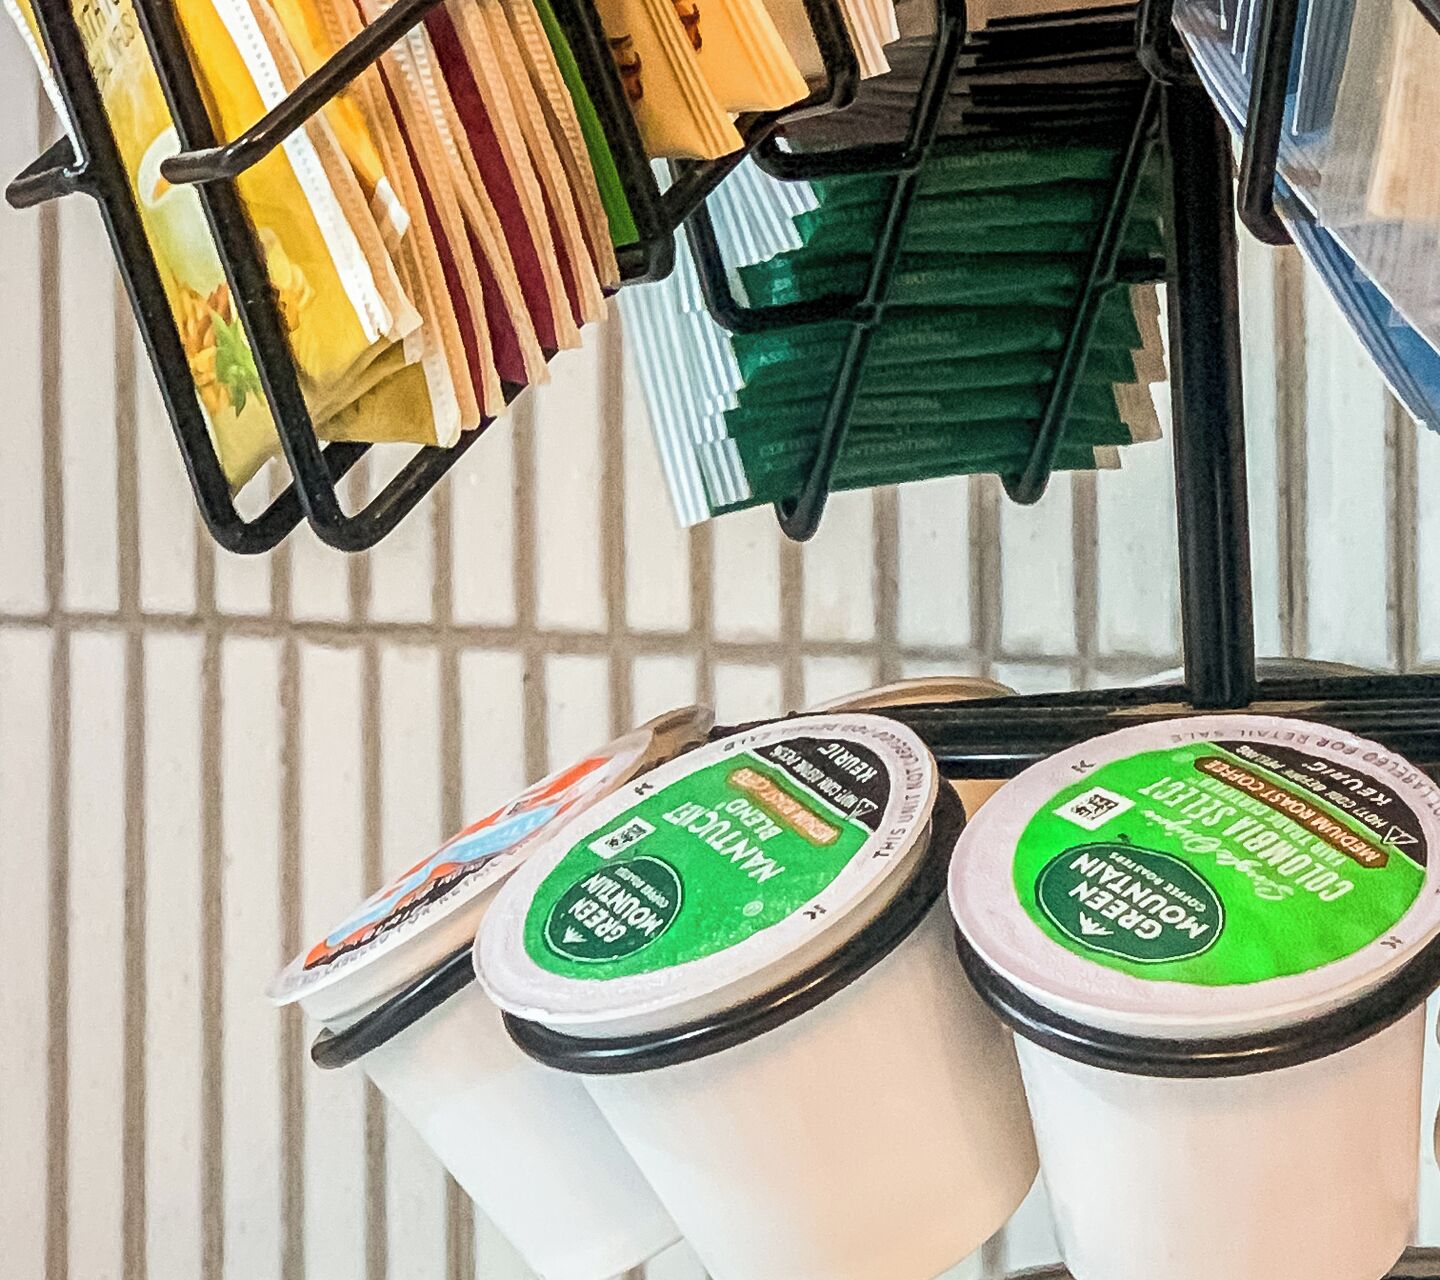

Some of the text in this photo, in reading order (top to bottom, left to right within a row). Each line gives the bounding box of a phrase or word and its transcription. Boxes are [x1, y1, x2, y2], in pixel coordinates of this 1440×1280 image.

[816, 743, 878, 784] KEURIG
[1315, 736, 1360, 756] FOR
[1202, 758, 1382, 863] MEDIUM ROAST COFFEE
[1303, 761, 1393, 807] KEURIG
[661, 800, 786, 884] NANTUCKET
[725, 798, 784, 841] BLEND
[872, 827, 907, 859] THIS
[899, 792, 922, 824] UNIT
[1138, 776, 1356, 903] COLOMBIA SELECT
[568, 897, 627, 943] GREEN
[1068, 852, 1211, 940] MOUNTAIN
[1068, 880, 1164, 940] GREEN
